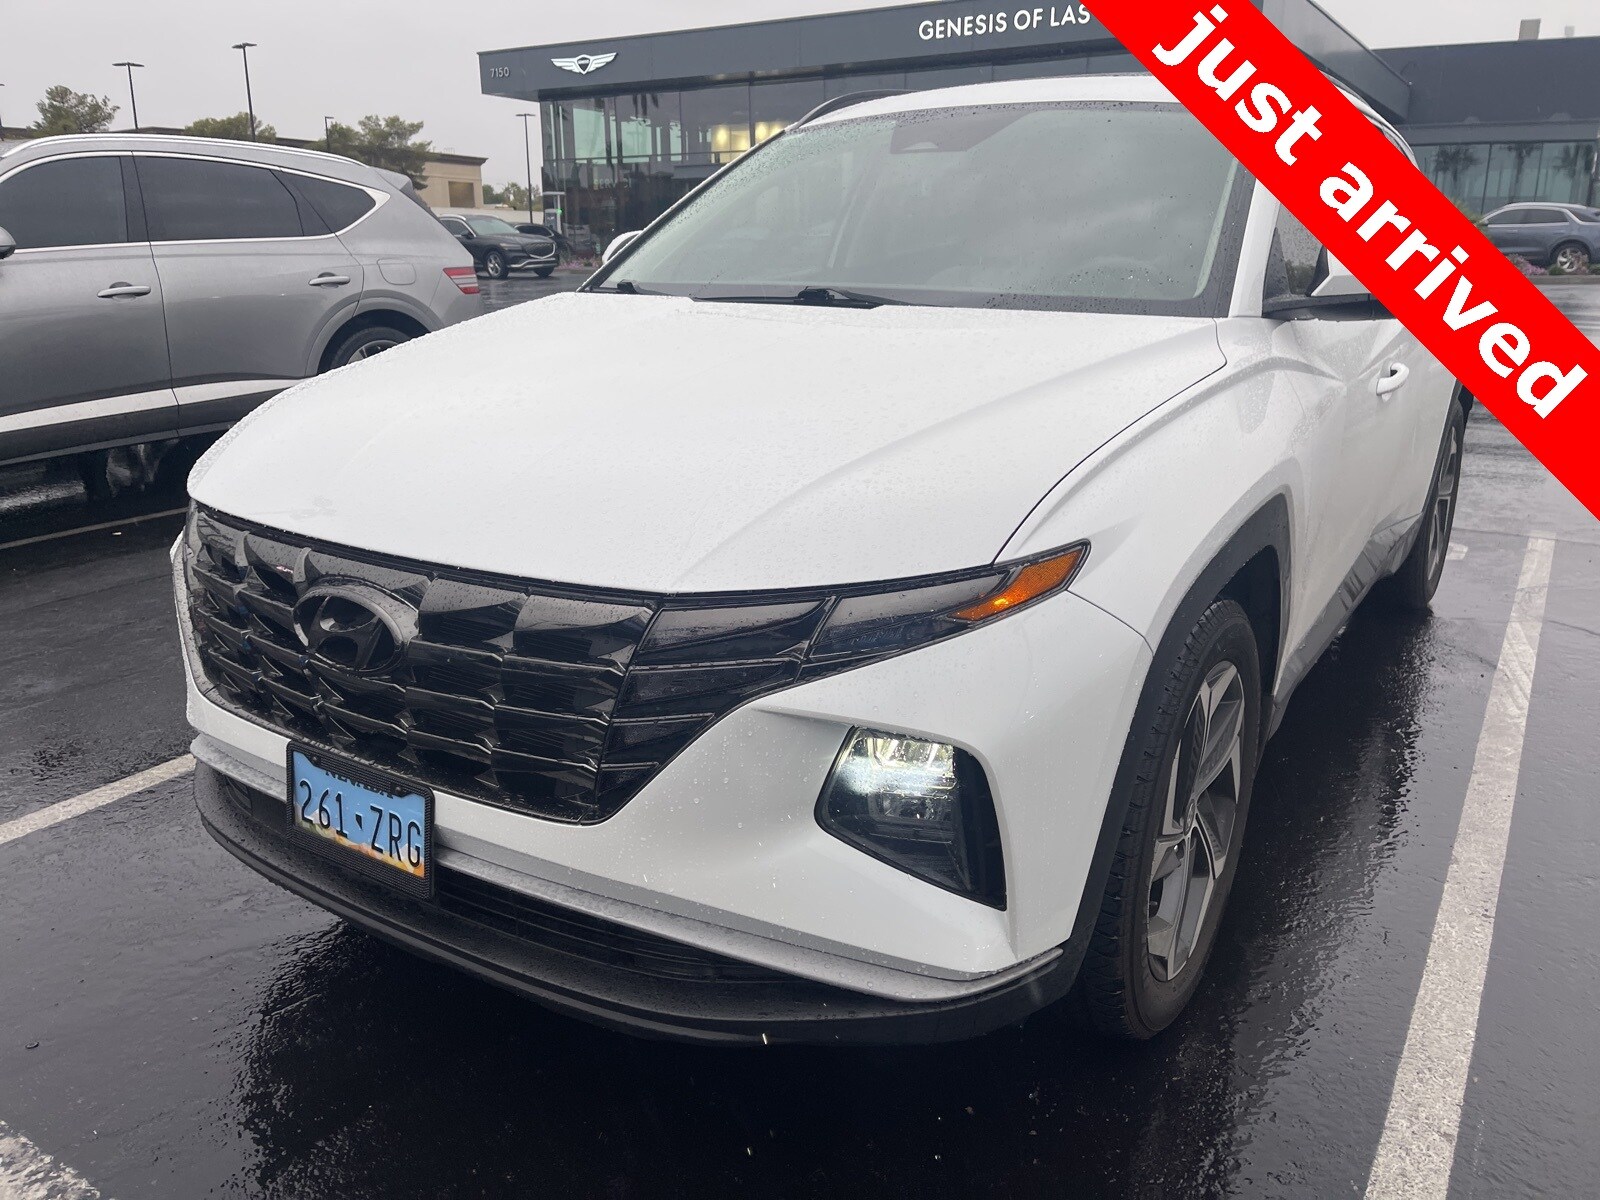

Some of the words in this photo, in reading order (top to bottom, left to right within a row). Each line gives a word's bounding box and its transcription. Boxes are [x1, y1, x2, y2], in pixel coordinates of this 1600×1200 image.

[919, 12, 1007, 40] GENESIS
[1014, 8, 1043, 30] OF
[1050, 4, 1090, 27] LAS
[489, 66, 510, 78] 7150
